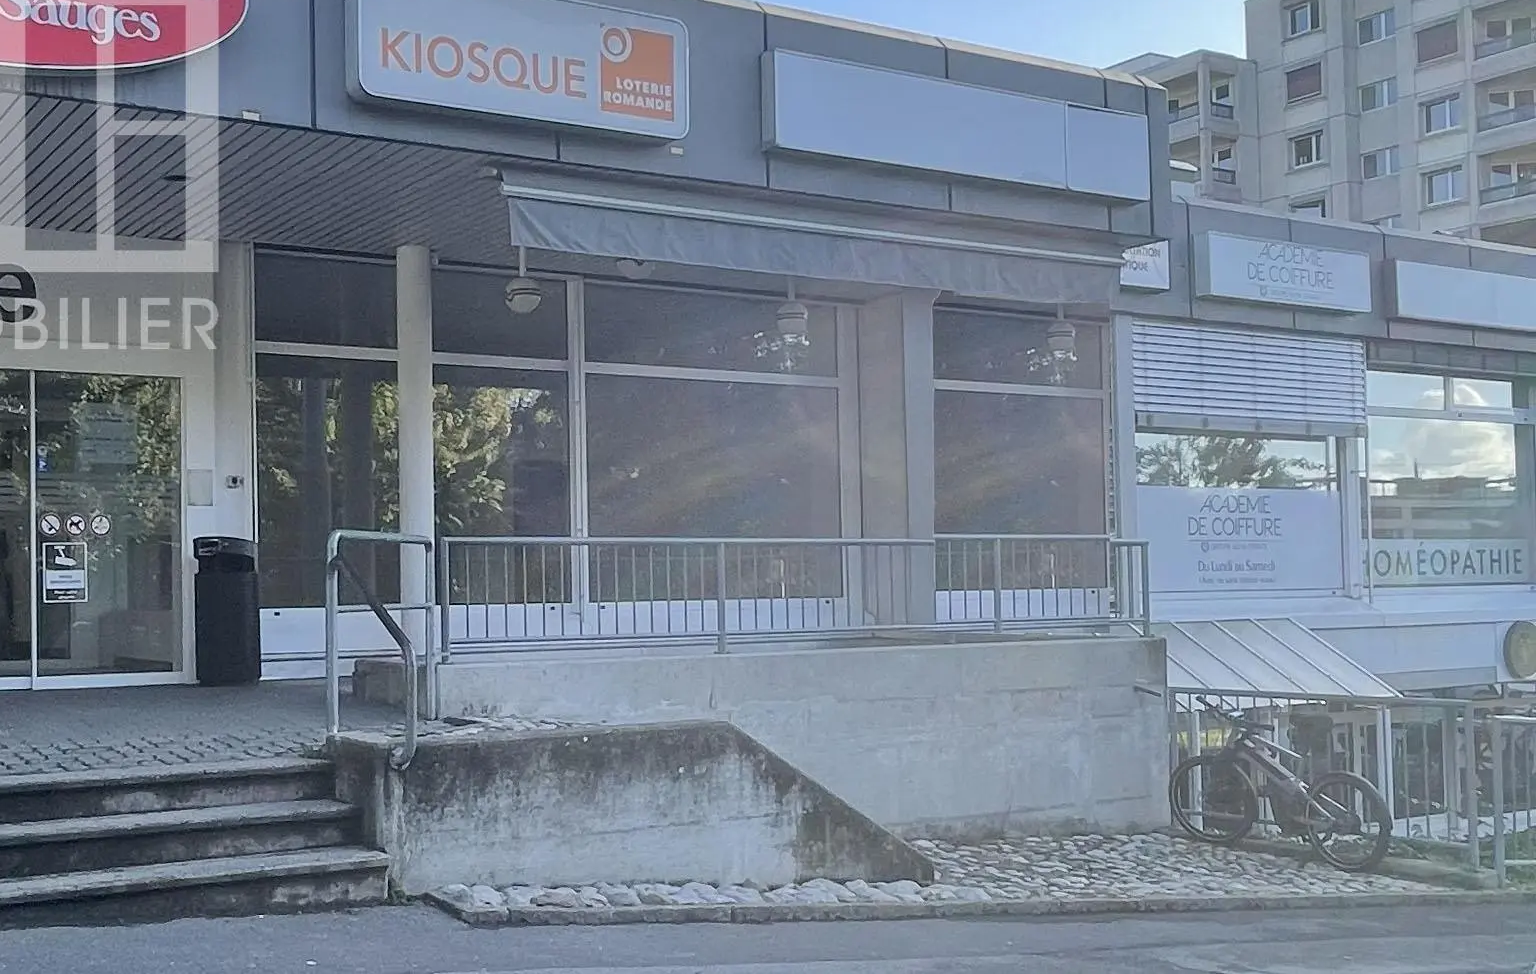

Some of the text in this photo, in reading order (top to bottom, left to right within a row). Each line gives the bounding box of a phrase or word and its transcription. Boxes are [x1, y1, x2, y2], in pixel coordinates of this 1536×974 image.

[379, 27, 587, 99] KIOSQUE
[615, 76, 672, 97] LOTERIE
[603, 90, 672, 112] ROMANDE
[1247, 260, 1334, 289] DE COIFFURE
[1187, 516, 1283, 537] DE COIFFURE
[1211, 560, 1233, 573] Lundi
[1245, 559, 1276, 573] Samedi
[1362, 541, 1524, 577] OMÉOPATHIE
